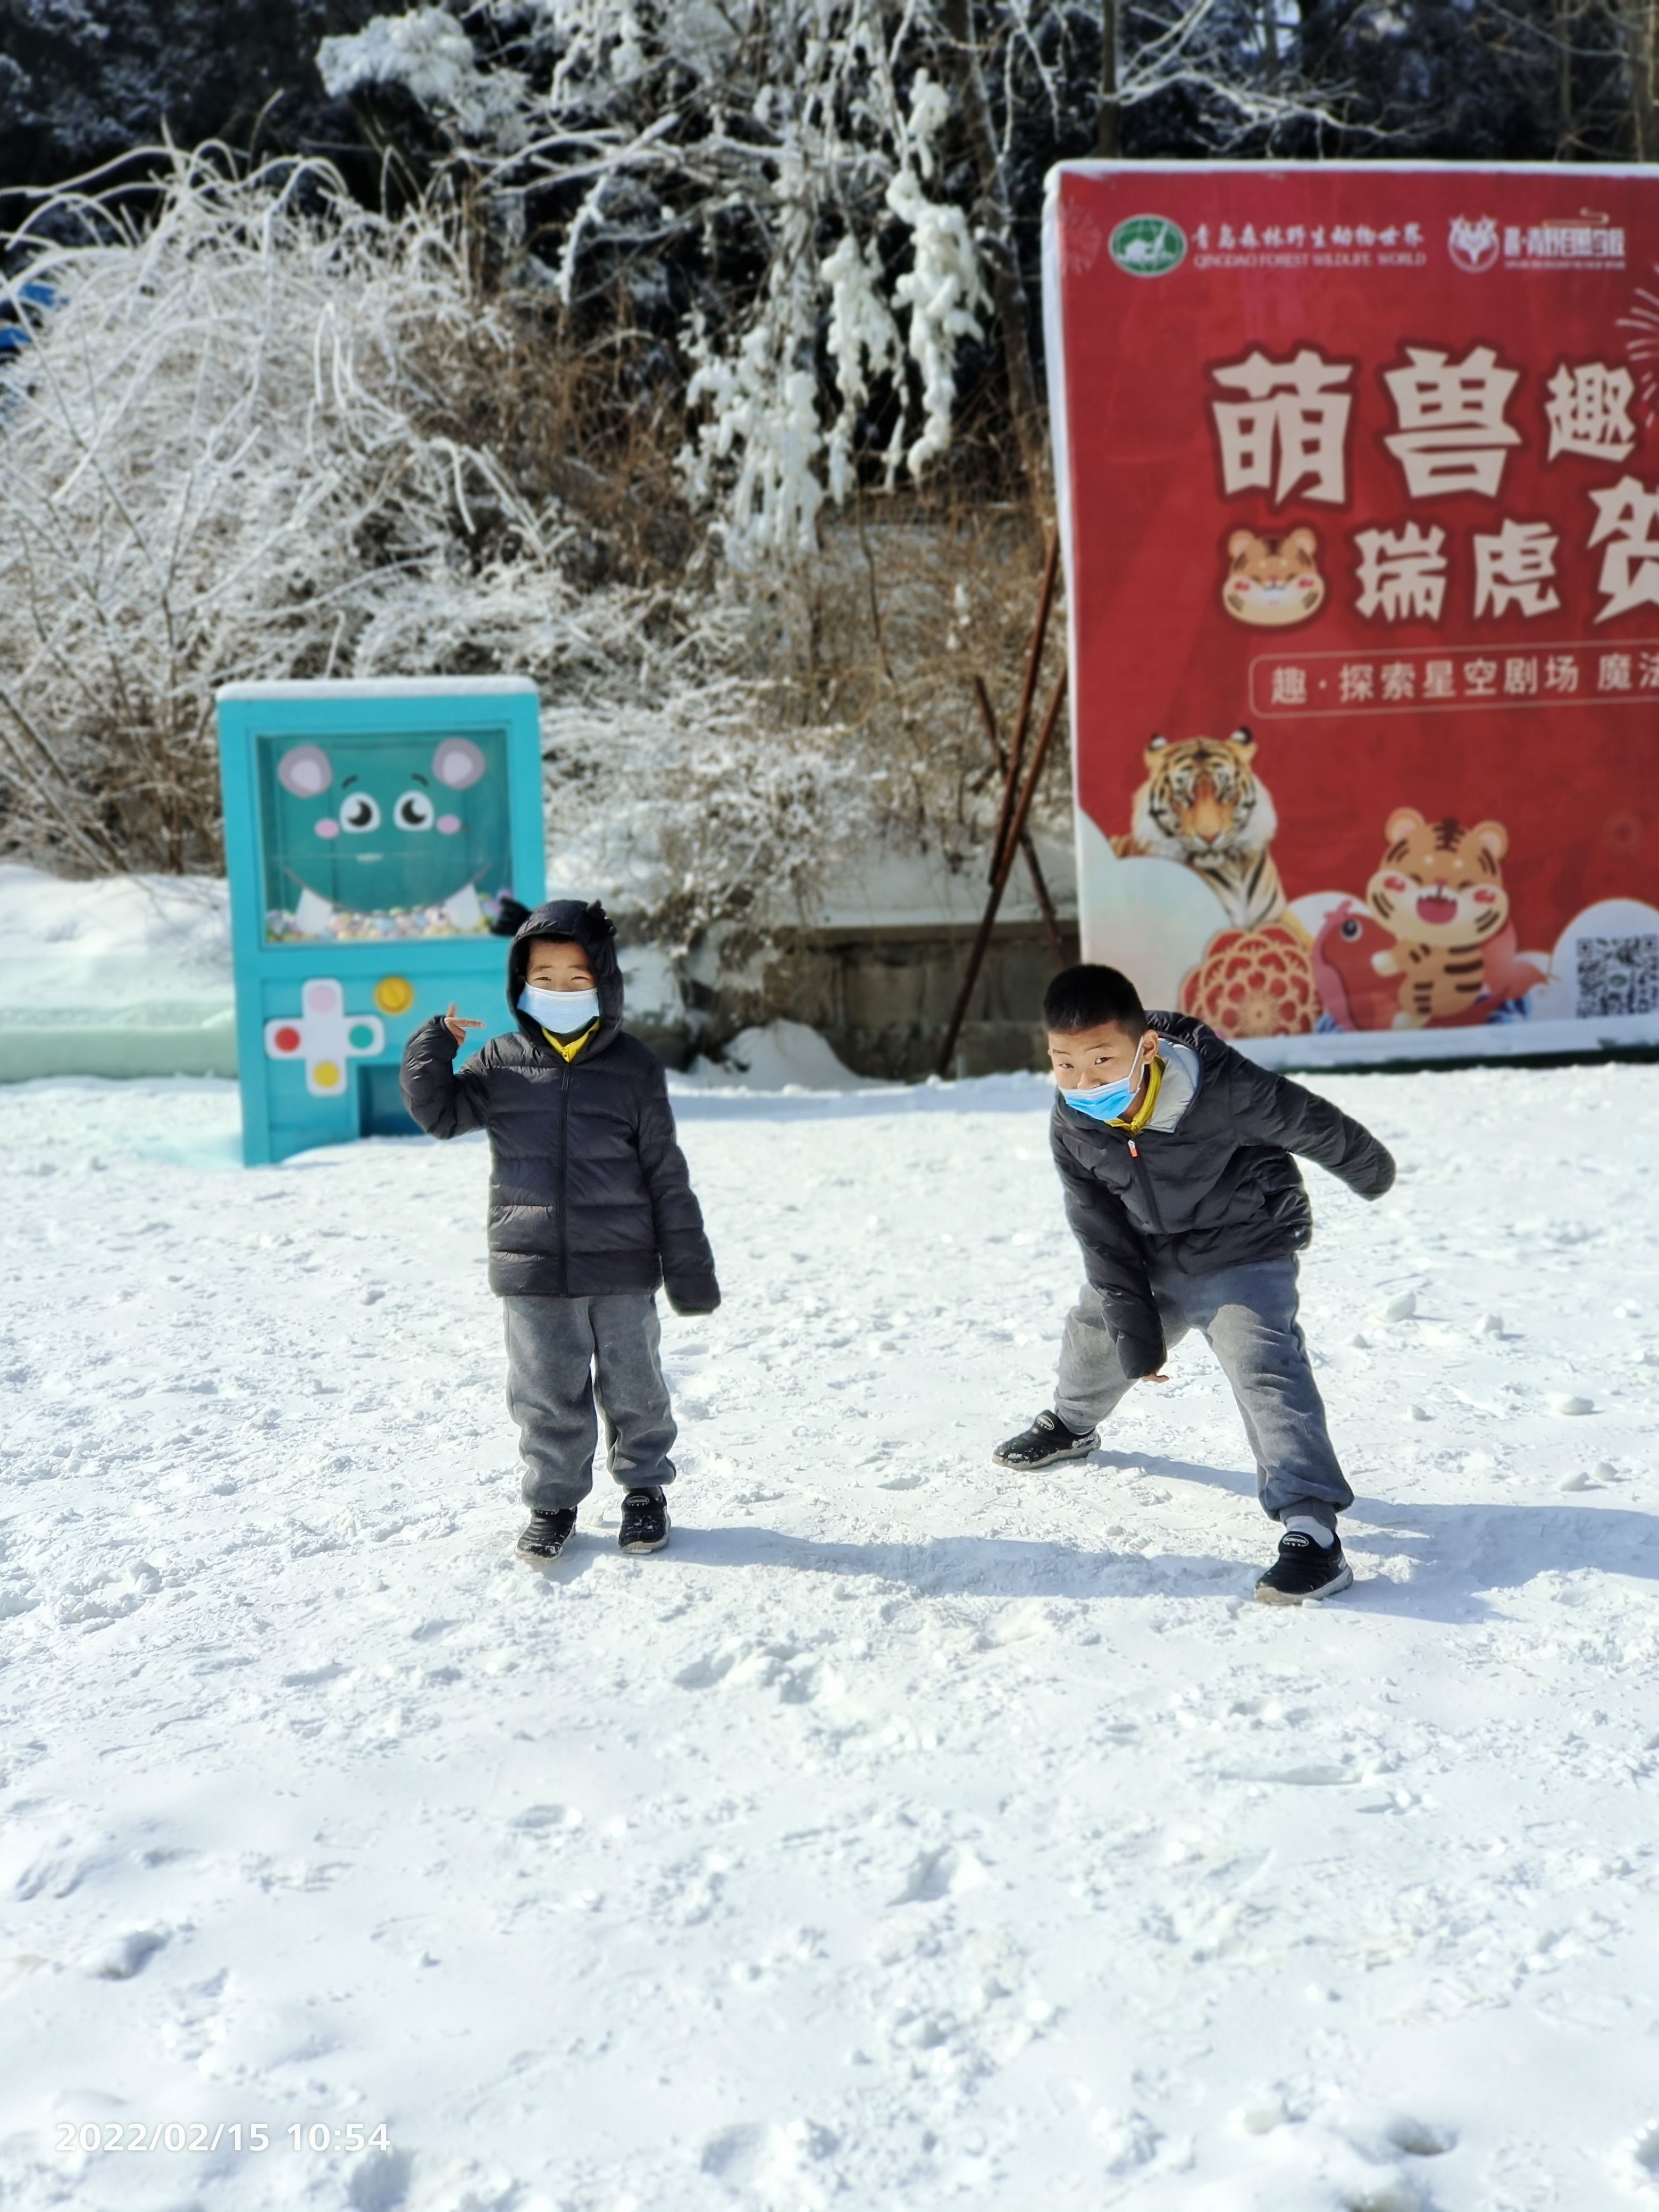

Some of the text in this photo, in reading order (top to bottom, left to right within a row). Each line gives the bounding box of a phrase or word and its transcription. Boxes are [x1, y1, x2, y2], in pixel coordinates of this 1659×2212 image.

[1259, 252, 1309, 268] FOREST
[1311, 251, 1372, 267] WILDLIFE
[1376, 250, 1428, 267] WORLD
[1211, 346, 1636, 507] 萌兽趣
